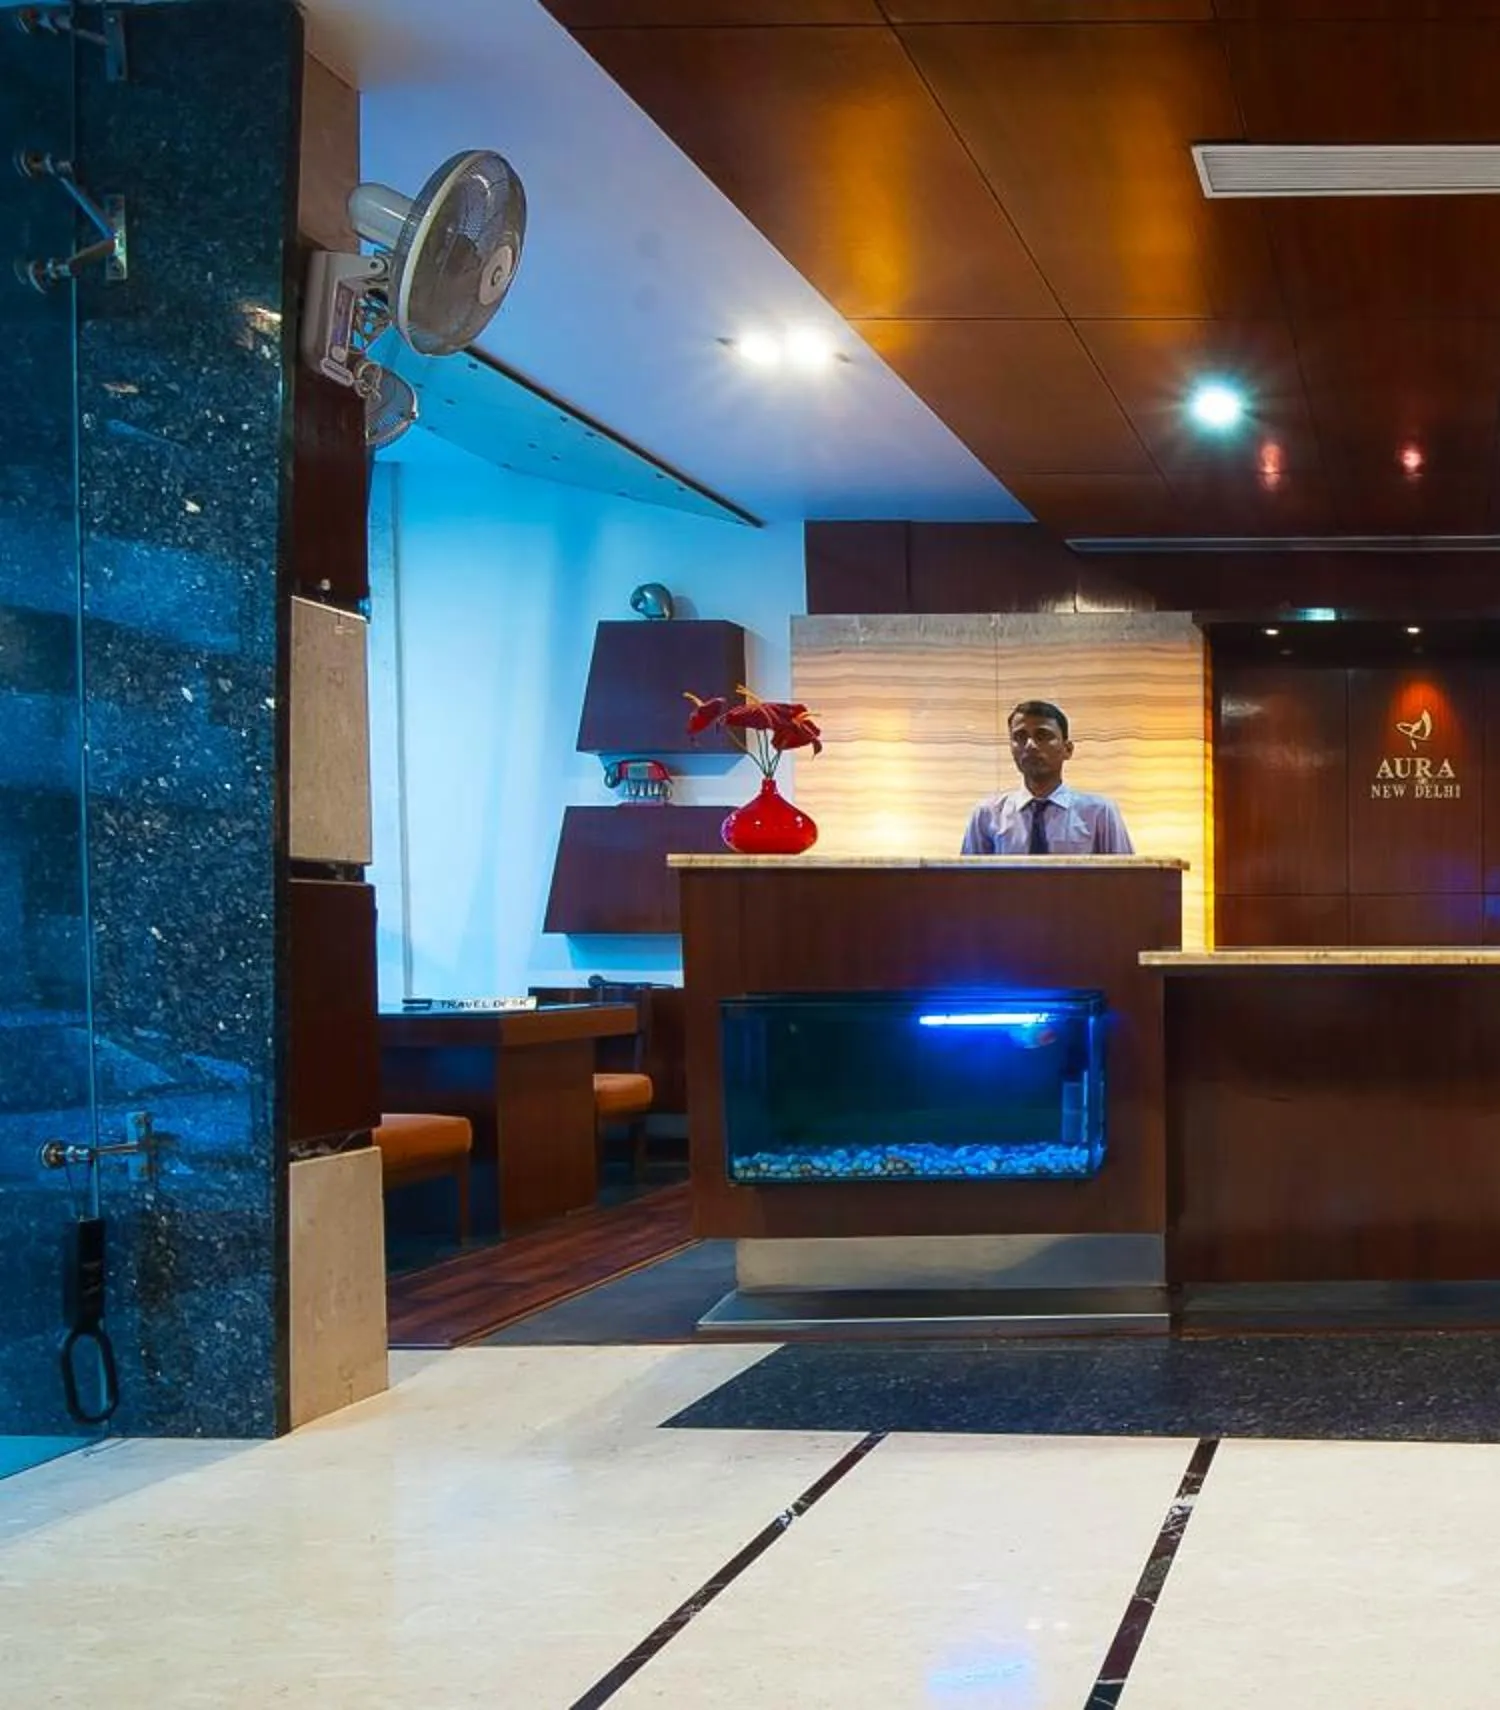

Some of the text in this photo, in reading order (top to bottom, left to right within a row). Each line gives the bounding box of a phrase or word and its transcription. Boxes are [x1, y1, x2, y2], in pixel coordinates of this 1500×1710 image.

[1376, 757, 1456, 779] AURA
[1371, 783, 1461, 799] NEW DELHI
[439, 999, 490, 1009] TRAVEL
